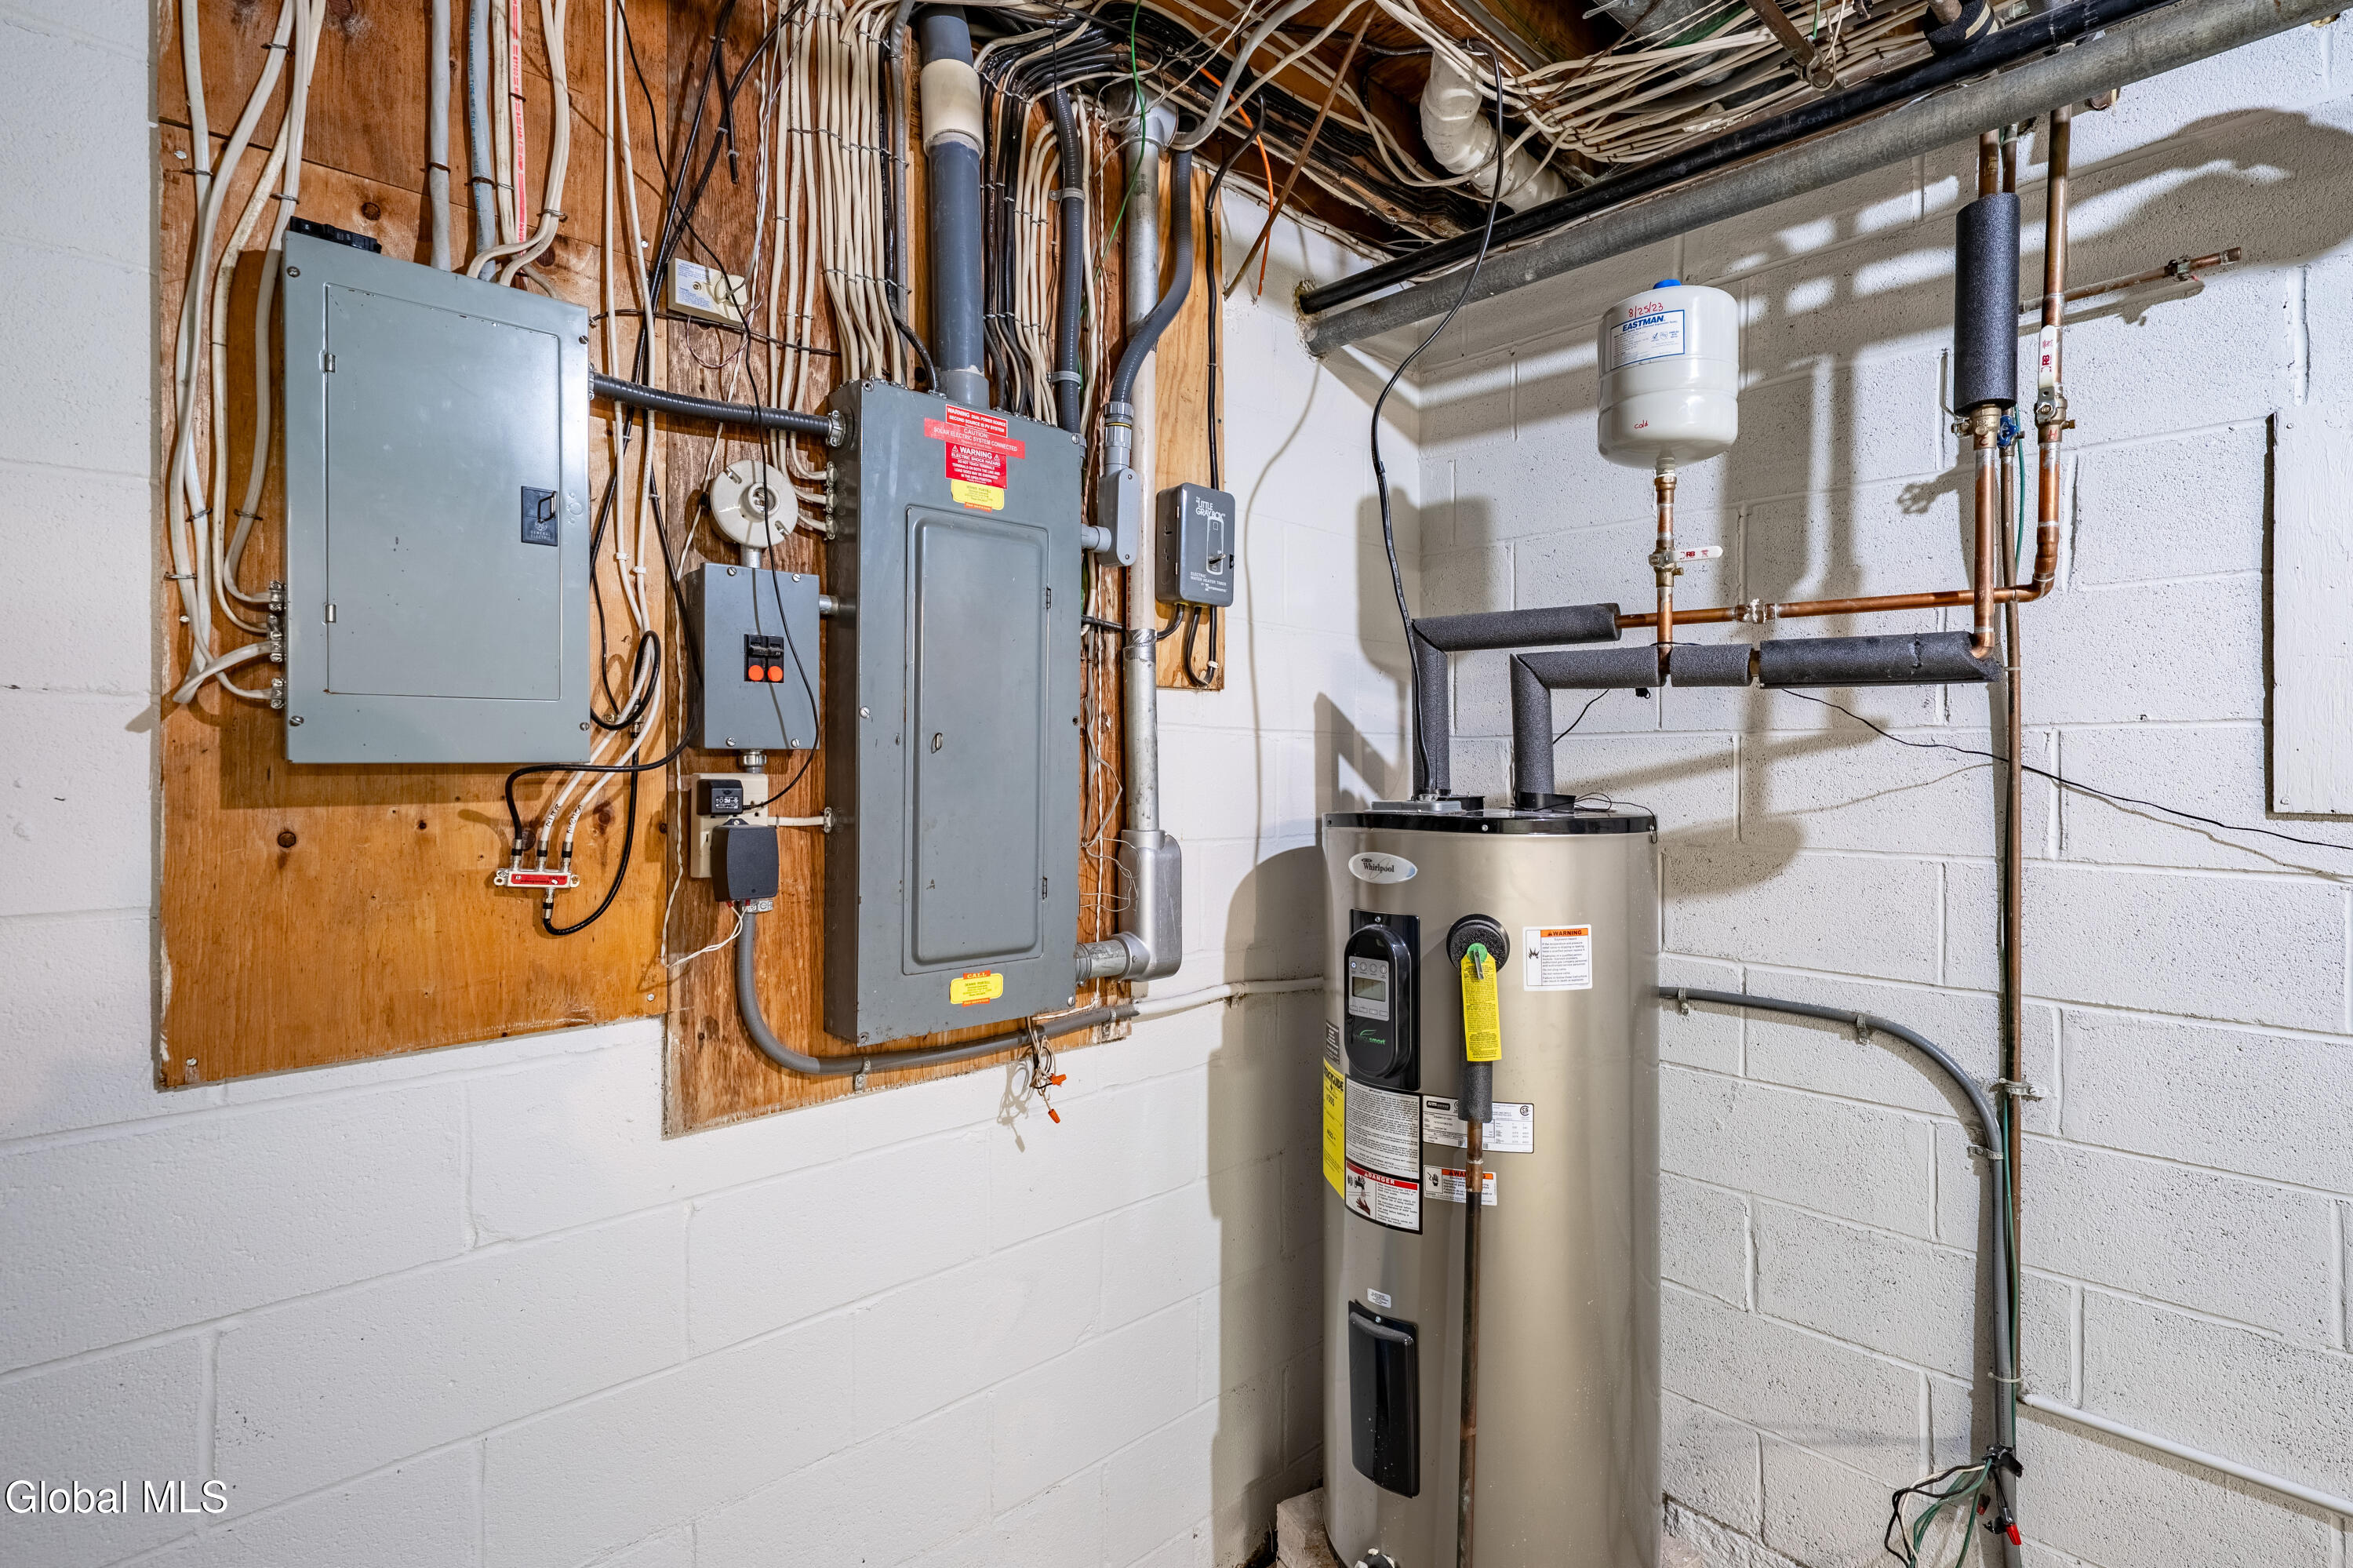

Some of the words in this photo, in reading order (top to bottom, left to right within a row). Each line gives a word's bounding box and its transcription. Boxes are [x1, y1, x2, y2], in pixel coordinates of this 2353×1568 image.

[1629, 302, 1663, 319] 8/25/23
[1623, 315, 1664, 332] EASTMAN
[947, 407, 970, 417] WARNING
[964, 428, 989, 438] CAUTION:
[934, 427, 949, 436] SOLAR
[950, 430, 972, 442] ELECTRIC
[973, 436, 991, 445] SYSTEM
[991, 440, 1017, 452] CONNECTED
[960, 446, 992, 459] WARNING
[1198, 500, 1213, 510] LITTLE
[1196, 507, 1211, 517] GRAY
[1363, 862, 1394, 873] Whirlpool
[1368, 1173, 1395, 1185] DANGER
